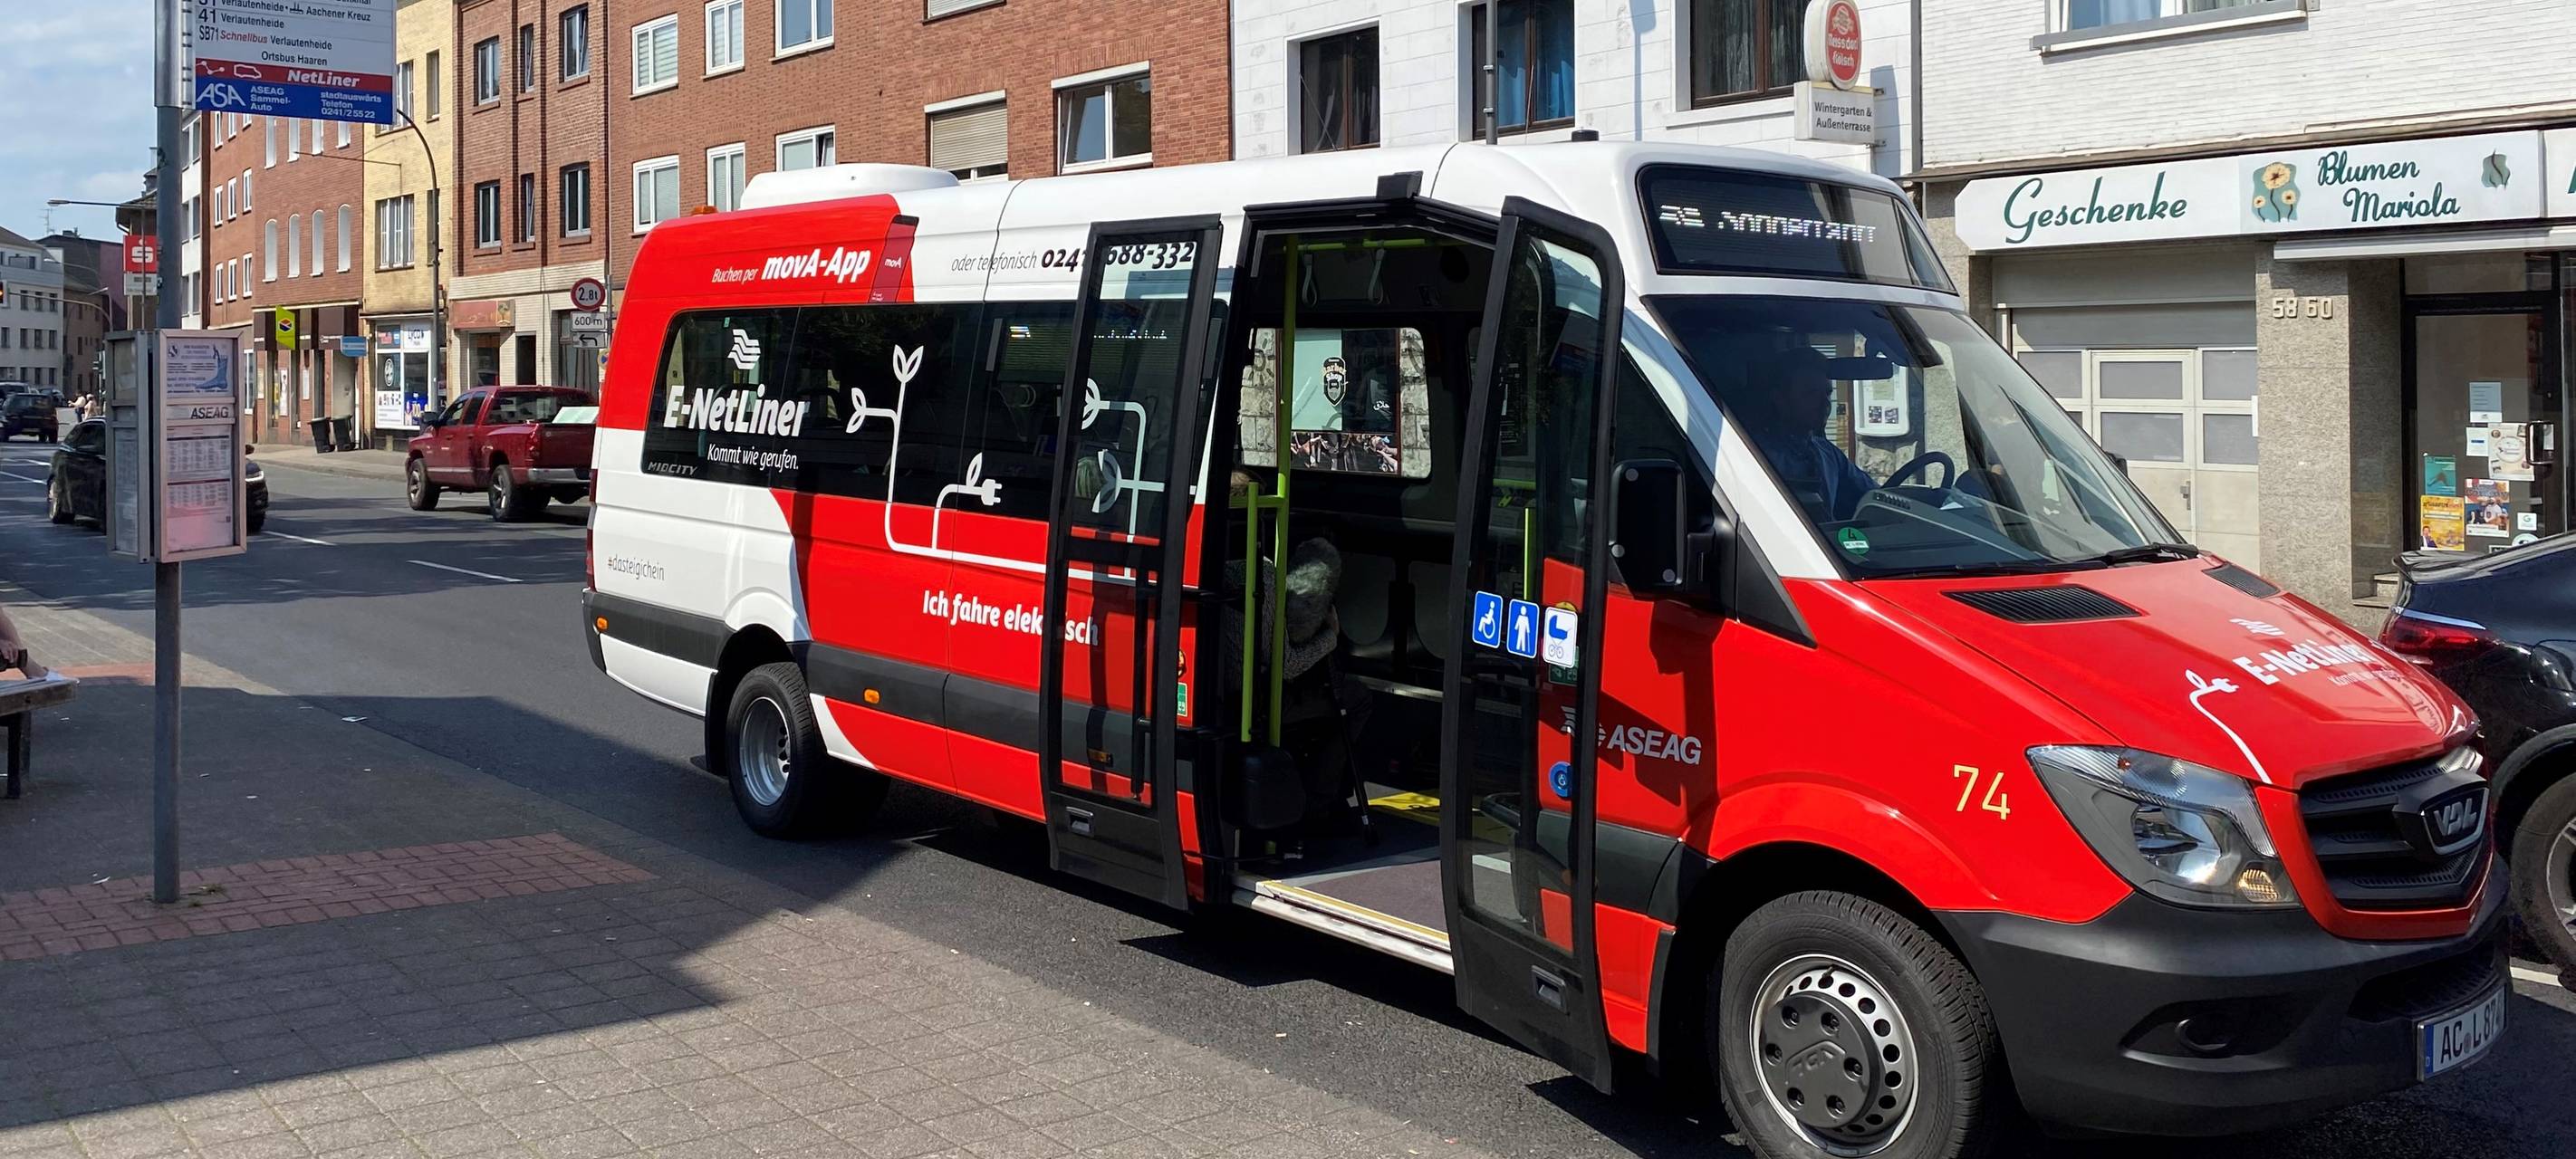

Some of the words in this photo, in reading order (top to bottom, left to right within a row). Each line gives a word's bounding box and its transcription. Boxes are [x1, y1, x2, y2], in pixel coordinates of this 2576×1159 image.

[197, 8, 216, 24] 41
[220, 13, 284, 28] Verlautenheide
[306, 5, 345, 18] Aachener
[347, 11, 371, 21] Kreuz
[198, 25, 218, 41] SB71
[220, 30, 268, 43] Schnellbus
[270, 35, 332, 50] Verlautenheide
[261, 51, 295, 62] Ortsbus
[297, 54, 328, 65] Haaren
[250, 85, 284, 96] ASEAG
[287, 69, 360, 88] NetLiner
[196, 82, 245, 108] ASA
[250, 94, 291, 104] Sammel-
[250, 102, 273, 111] Auto
[321, 99, 353, 109] Telefon
[1814, 101, 1866, 118] Wintergarten
[1866, 108, 1872, 118] &
[1816, 118, 1871, 132] Außenterrasse
[2318, 150, 2420, 186] Blumen
[2004, 170, 2187, 244] Geschenke
[2342, 181, 2461, 222] Mariola
[712, 267, 743, 283] Buchen
[742, 268, 759, 284] per
[761, 246, 871, 283] movA-App
[951, 254, 976, 272] oder
[977, 250, 1037, 275] telefonisch
[574, 316, 591, 326] 600
[2273, 297, 2298, 319] 58
[2305, 297, 2333, 320] 60
[190, 407, 228, 419] ASEAG
[663, 383, 811, 436] E-NetLiner
[707, 443, 742, 465] Kommt
[742, 446, 761, 465] wie
[760, 448, 799, 473] gerufen.
[608, 553, 665, 580] #dasteigichein
[922, 589, 949, 618] Ich
[950, 593, 1001, 627] fahre
[1004, 604, 1099, 646] eleksch
[1606, 724, 1702, 765] ASEAG
[1954, 764, 2011, 820] 74
[2433, 797, 2477, 837] VDL
[2440, 1020, 2463, 1064] AC
[2473, 1012, 2482, 1048] L
